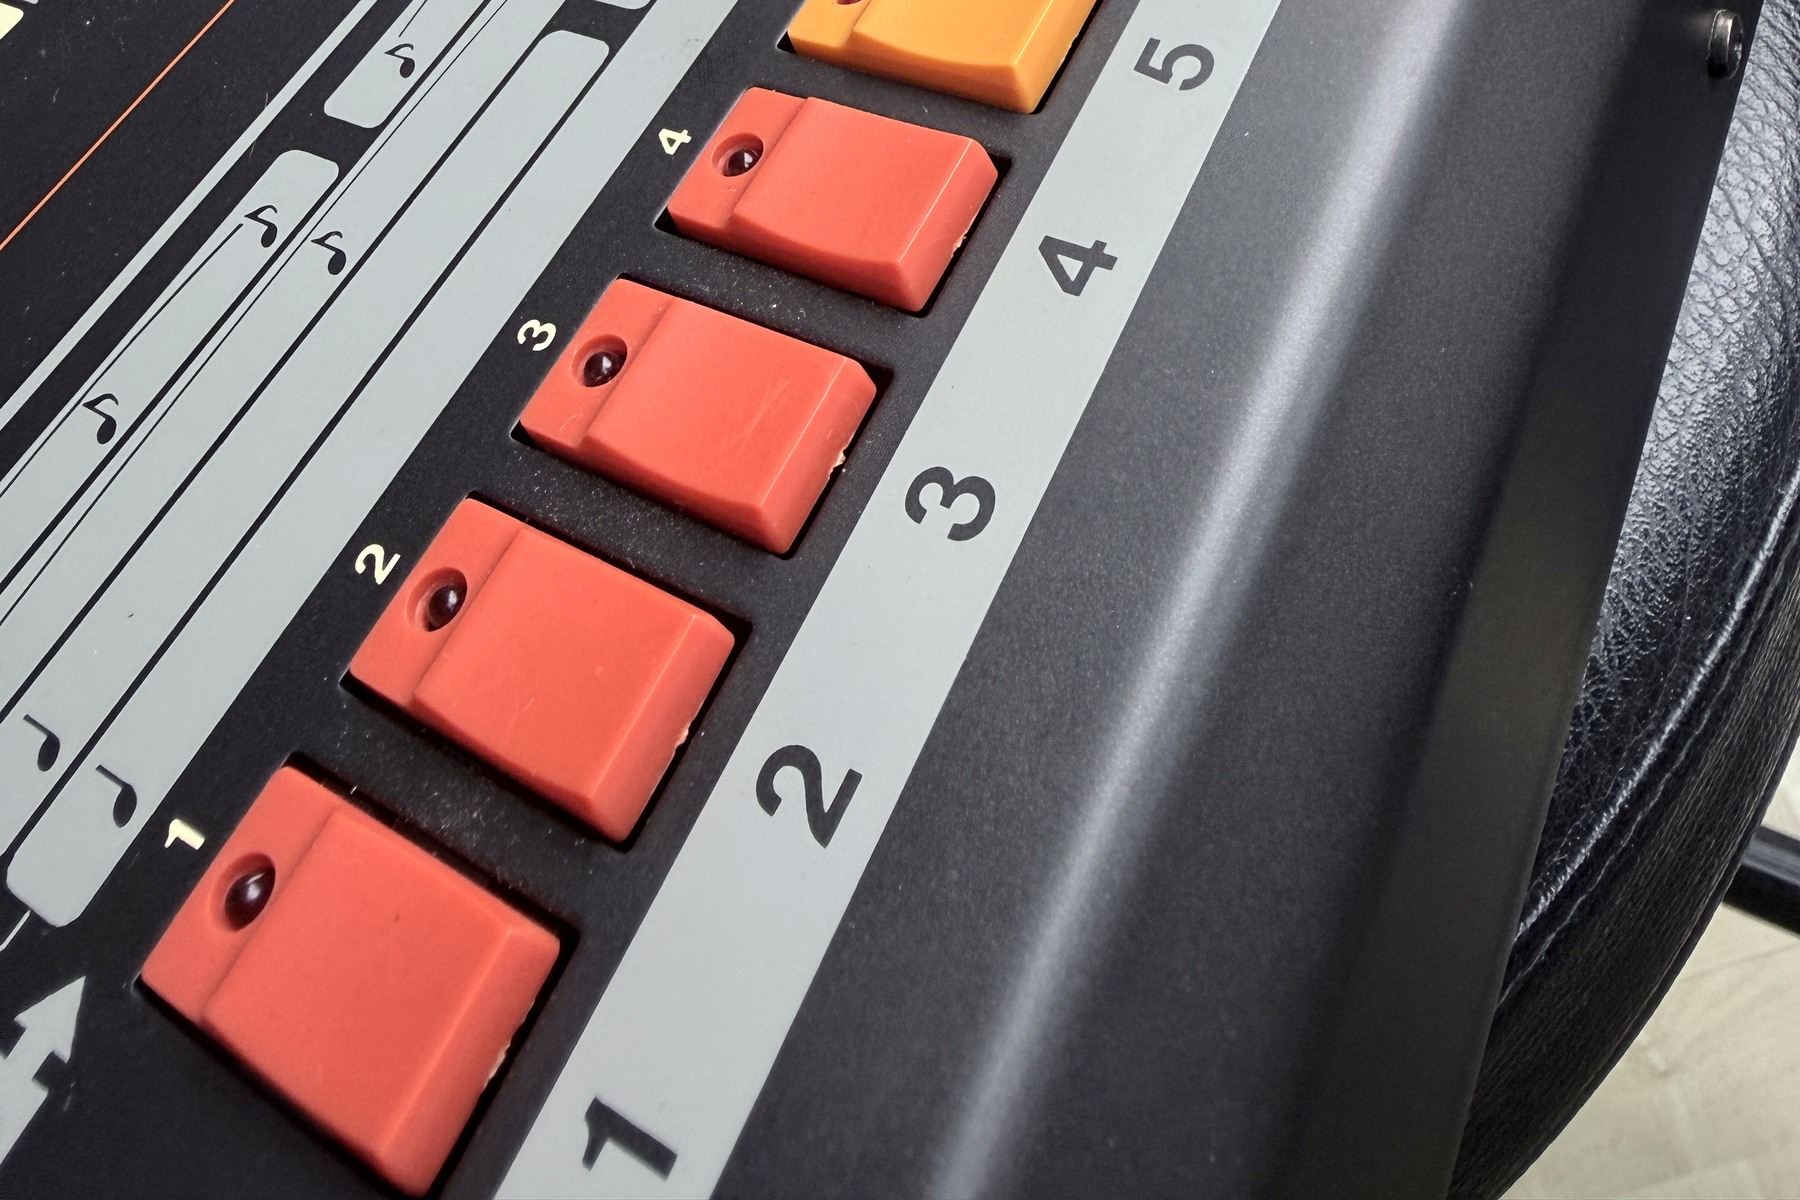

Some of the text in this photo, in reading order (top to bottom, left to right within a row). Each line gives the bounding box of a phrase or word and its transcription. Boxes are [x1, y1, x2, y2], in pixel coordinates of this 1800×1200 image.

[1133, 37, 1215, 91] 5
[658, 128, 692, 156] 4
[1038, 234, 1118, 297] 4
[516, 319, 558, 352] 3
[904, 466, 996, 542] 3
[354, 544, 400, 584] 2
[756, 744, 863, 849] 2
[164, 818, 205, 850] 1
[582, 1097, 678, 1181] 1
